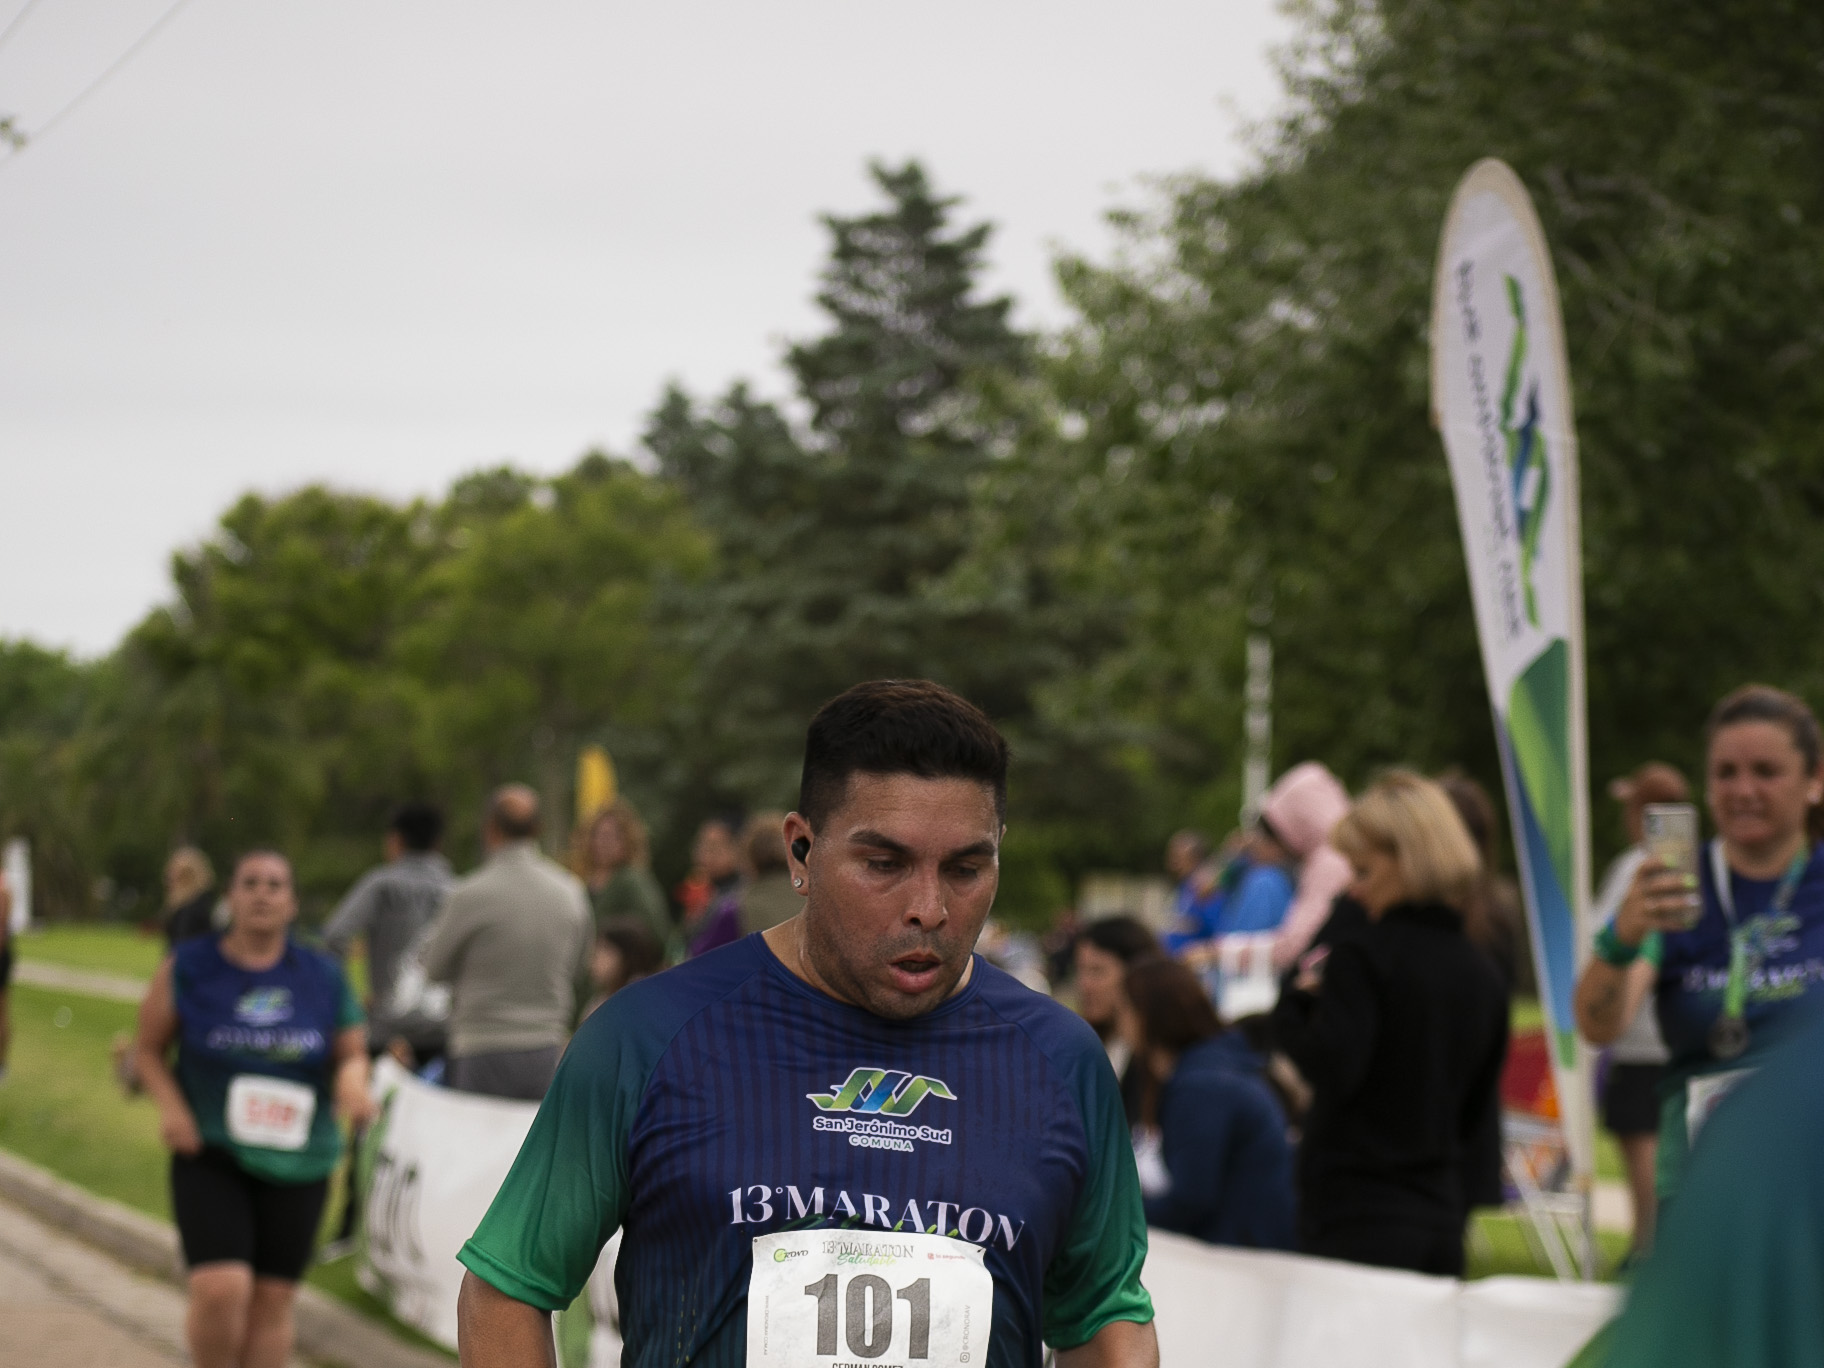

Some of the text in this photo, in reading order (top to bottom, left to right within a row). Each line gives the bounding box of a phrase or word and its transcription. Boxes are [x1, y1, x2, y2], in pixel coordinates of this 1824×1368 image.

[814, 1117, 950, 1143] San Jerónimo Sud
[850, 1136, 913, 1150] COMUNA
[804, 1273, 930, 1359] 101
